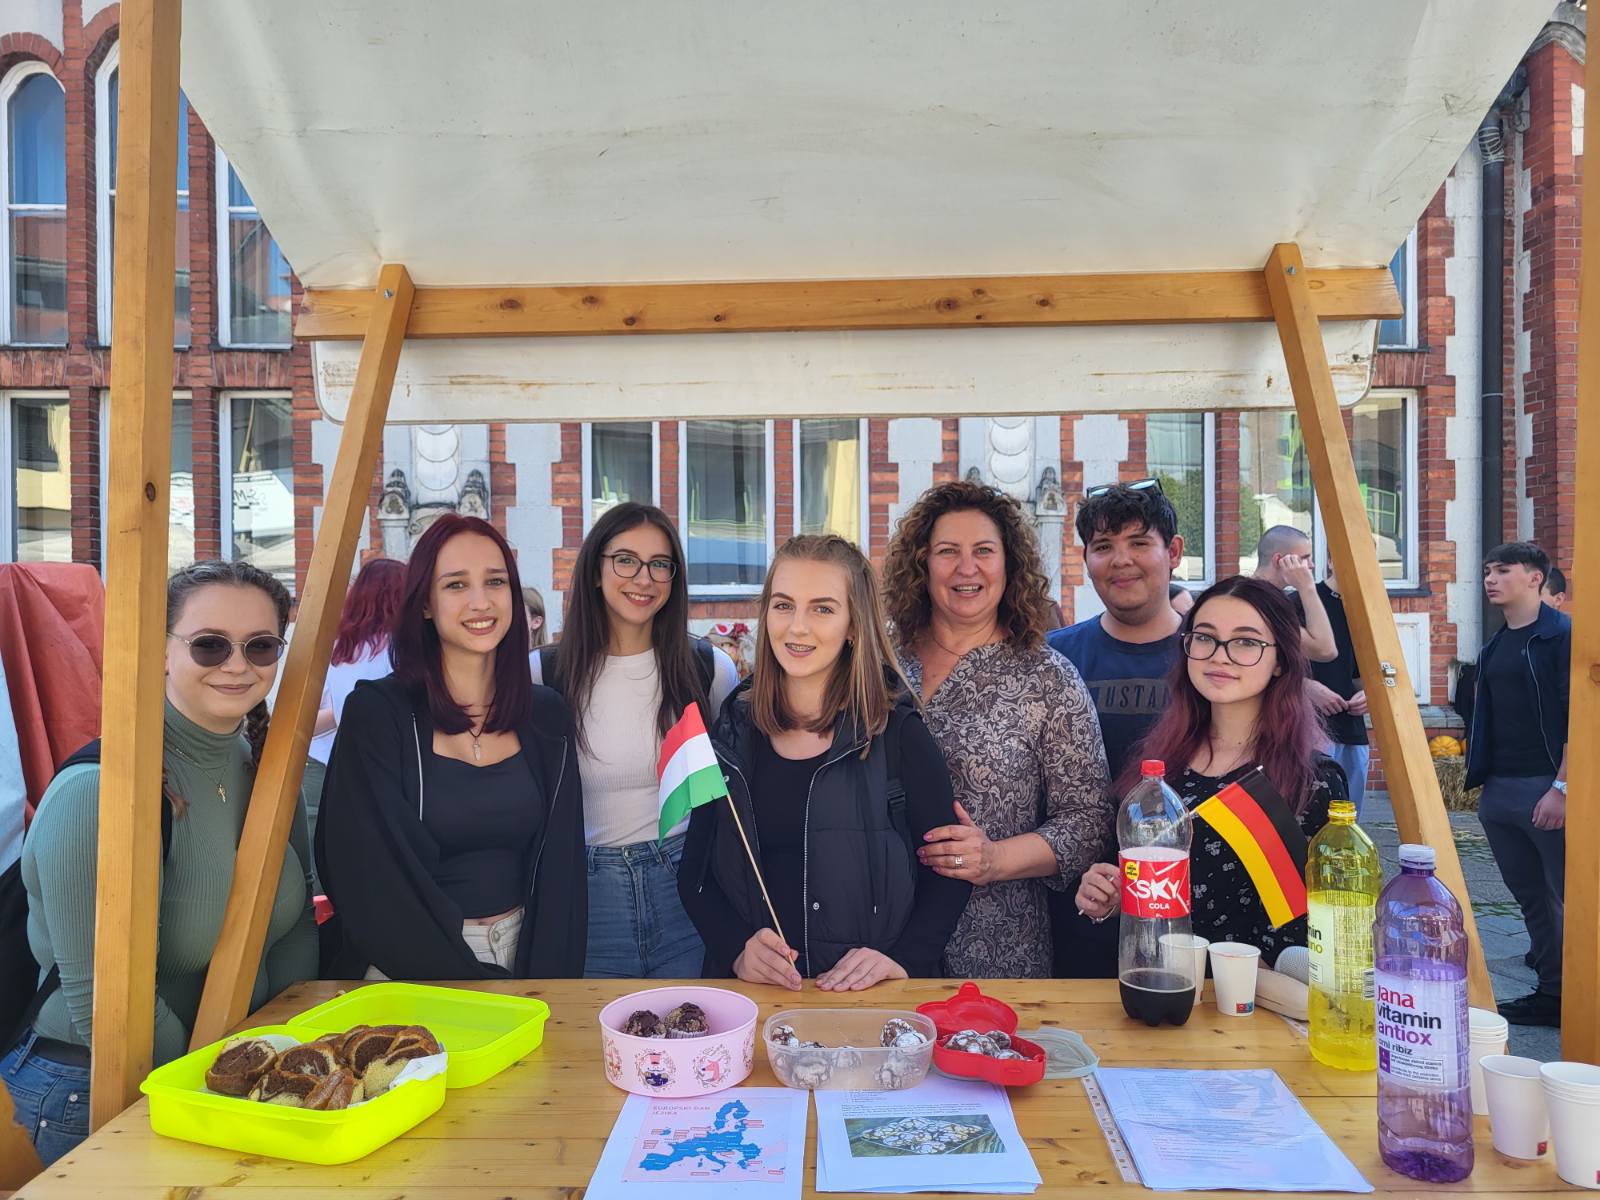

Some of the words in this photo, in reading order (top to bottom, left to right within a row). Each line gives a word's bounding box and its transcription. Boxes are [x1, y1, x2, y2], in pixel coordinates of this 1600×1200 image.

[1136, 878, 1180, 901] SKY
[1148, 902, 1170, 910] COLA
[1378, 1002, 1442, 1030] vitamin
[1378, 1020, 1432, 1046] antiox
[1392, 1043, 1413, 1055] ribiz
